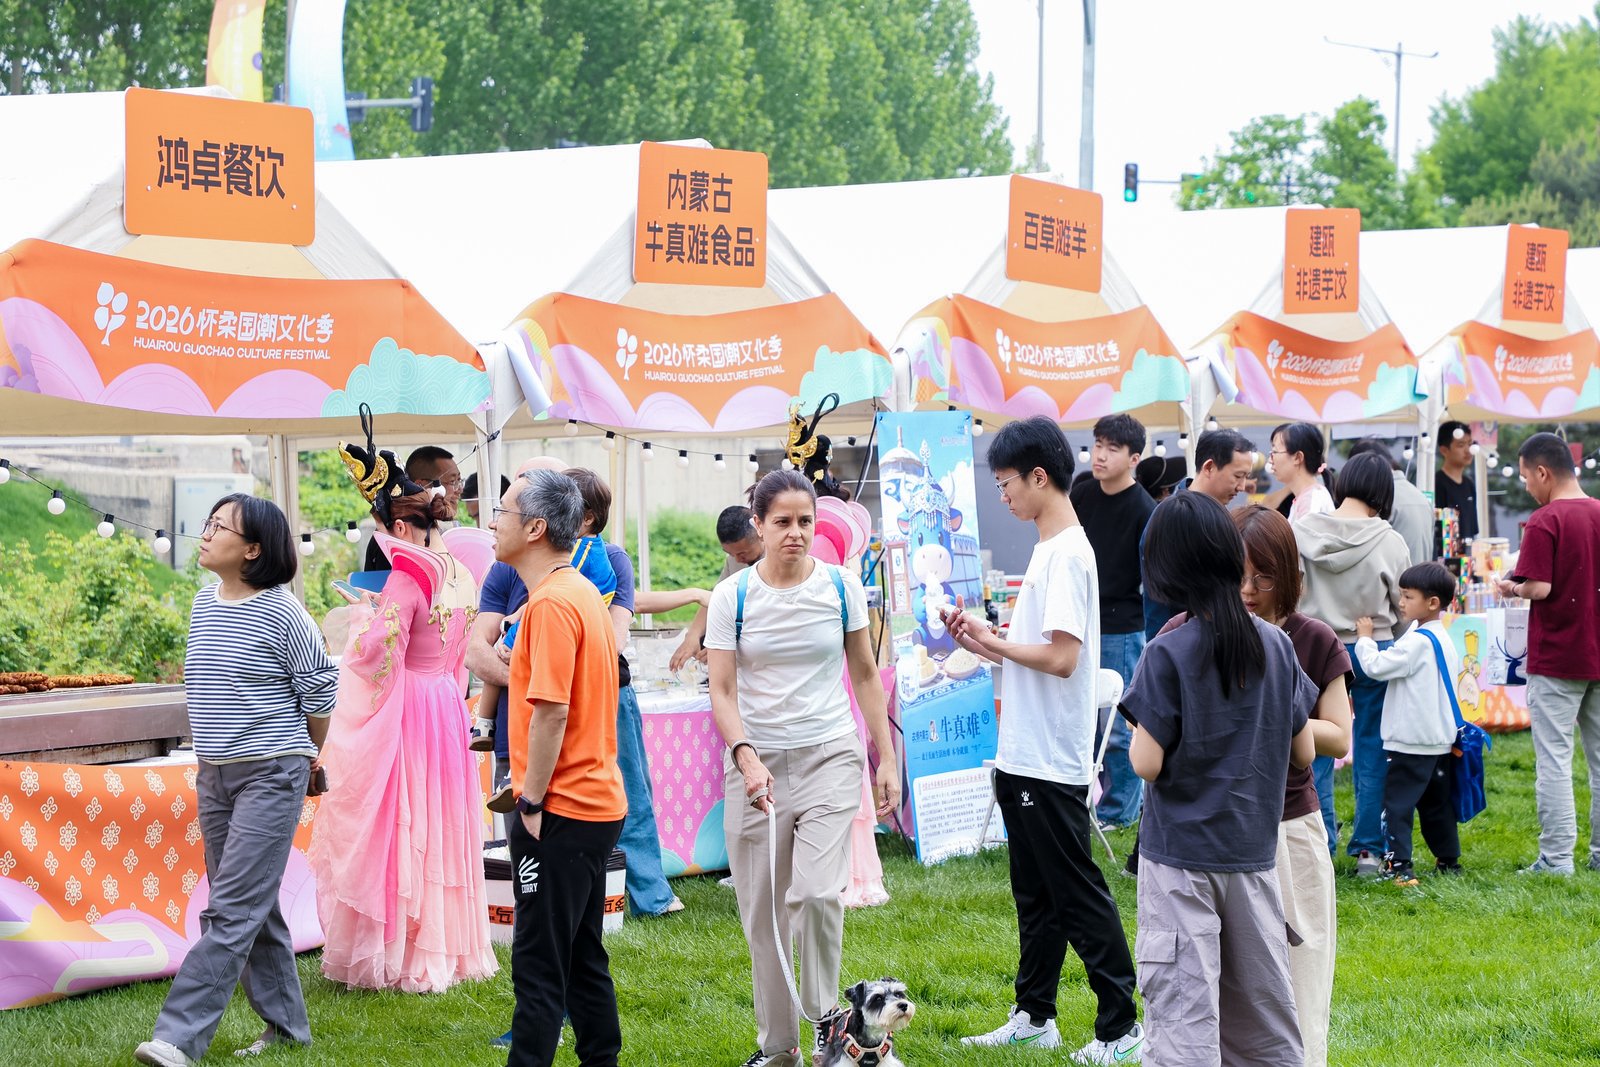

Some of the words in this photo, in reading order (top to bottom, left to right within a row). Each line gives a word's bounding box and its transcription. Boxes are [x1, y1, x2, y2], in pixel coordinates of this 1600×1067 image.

[157, 134, 286, 200] 鸿卓餐饮
[667, 168, 733, 213] 内蒙古
[645, 220, 755, 267] 牛真难食品
[1024, 210, 1087, 259] 百草滩羊
[1308, 224, 1335, 257] 建瓯
[1296, 267, 1348, 301] 非遗芋饺
[1512, 279, 1555, 312] 非遗芋饺
[135, 300, 335, 344] 2026怀柔国潮文化季
[133, 336, 182, 353] HUAIROU
[183, 343, 235, 358] GUOCHAO
[237, 347, 282, 360] CULTURE
[283, 348, 331, 360] FESTIVAL
[644, 370, 677, 383] HUAIROU
[677, 372, 714, 383] GUOCHAO
[715, 370, 749, 383] CULTURE
[750, 364, 785, 379] FESTIVAL
[521, 882, 538, 894] CURRY
